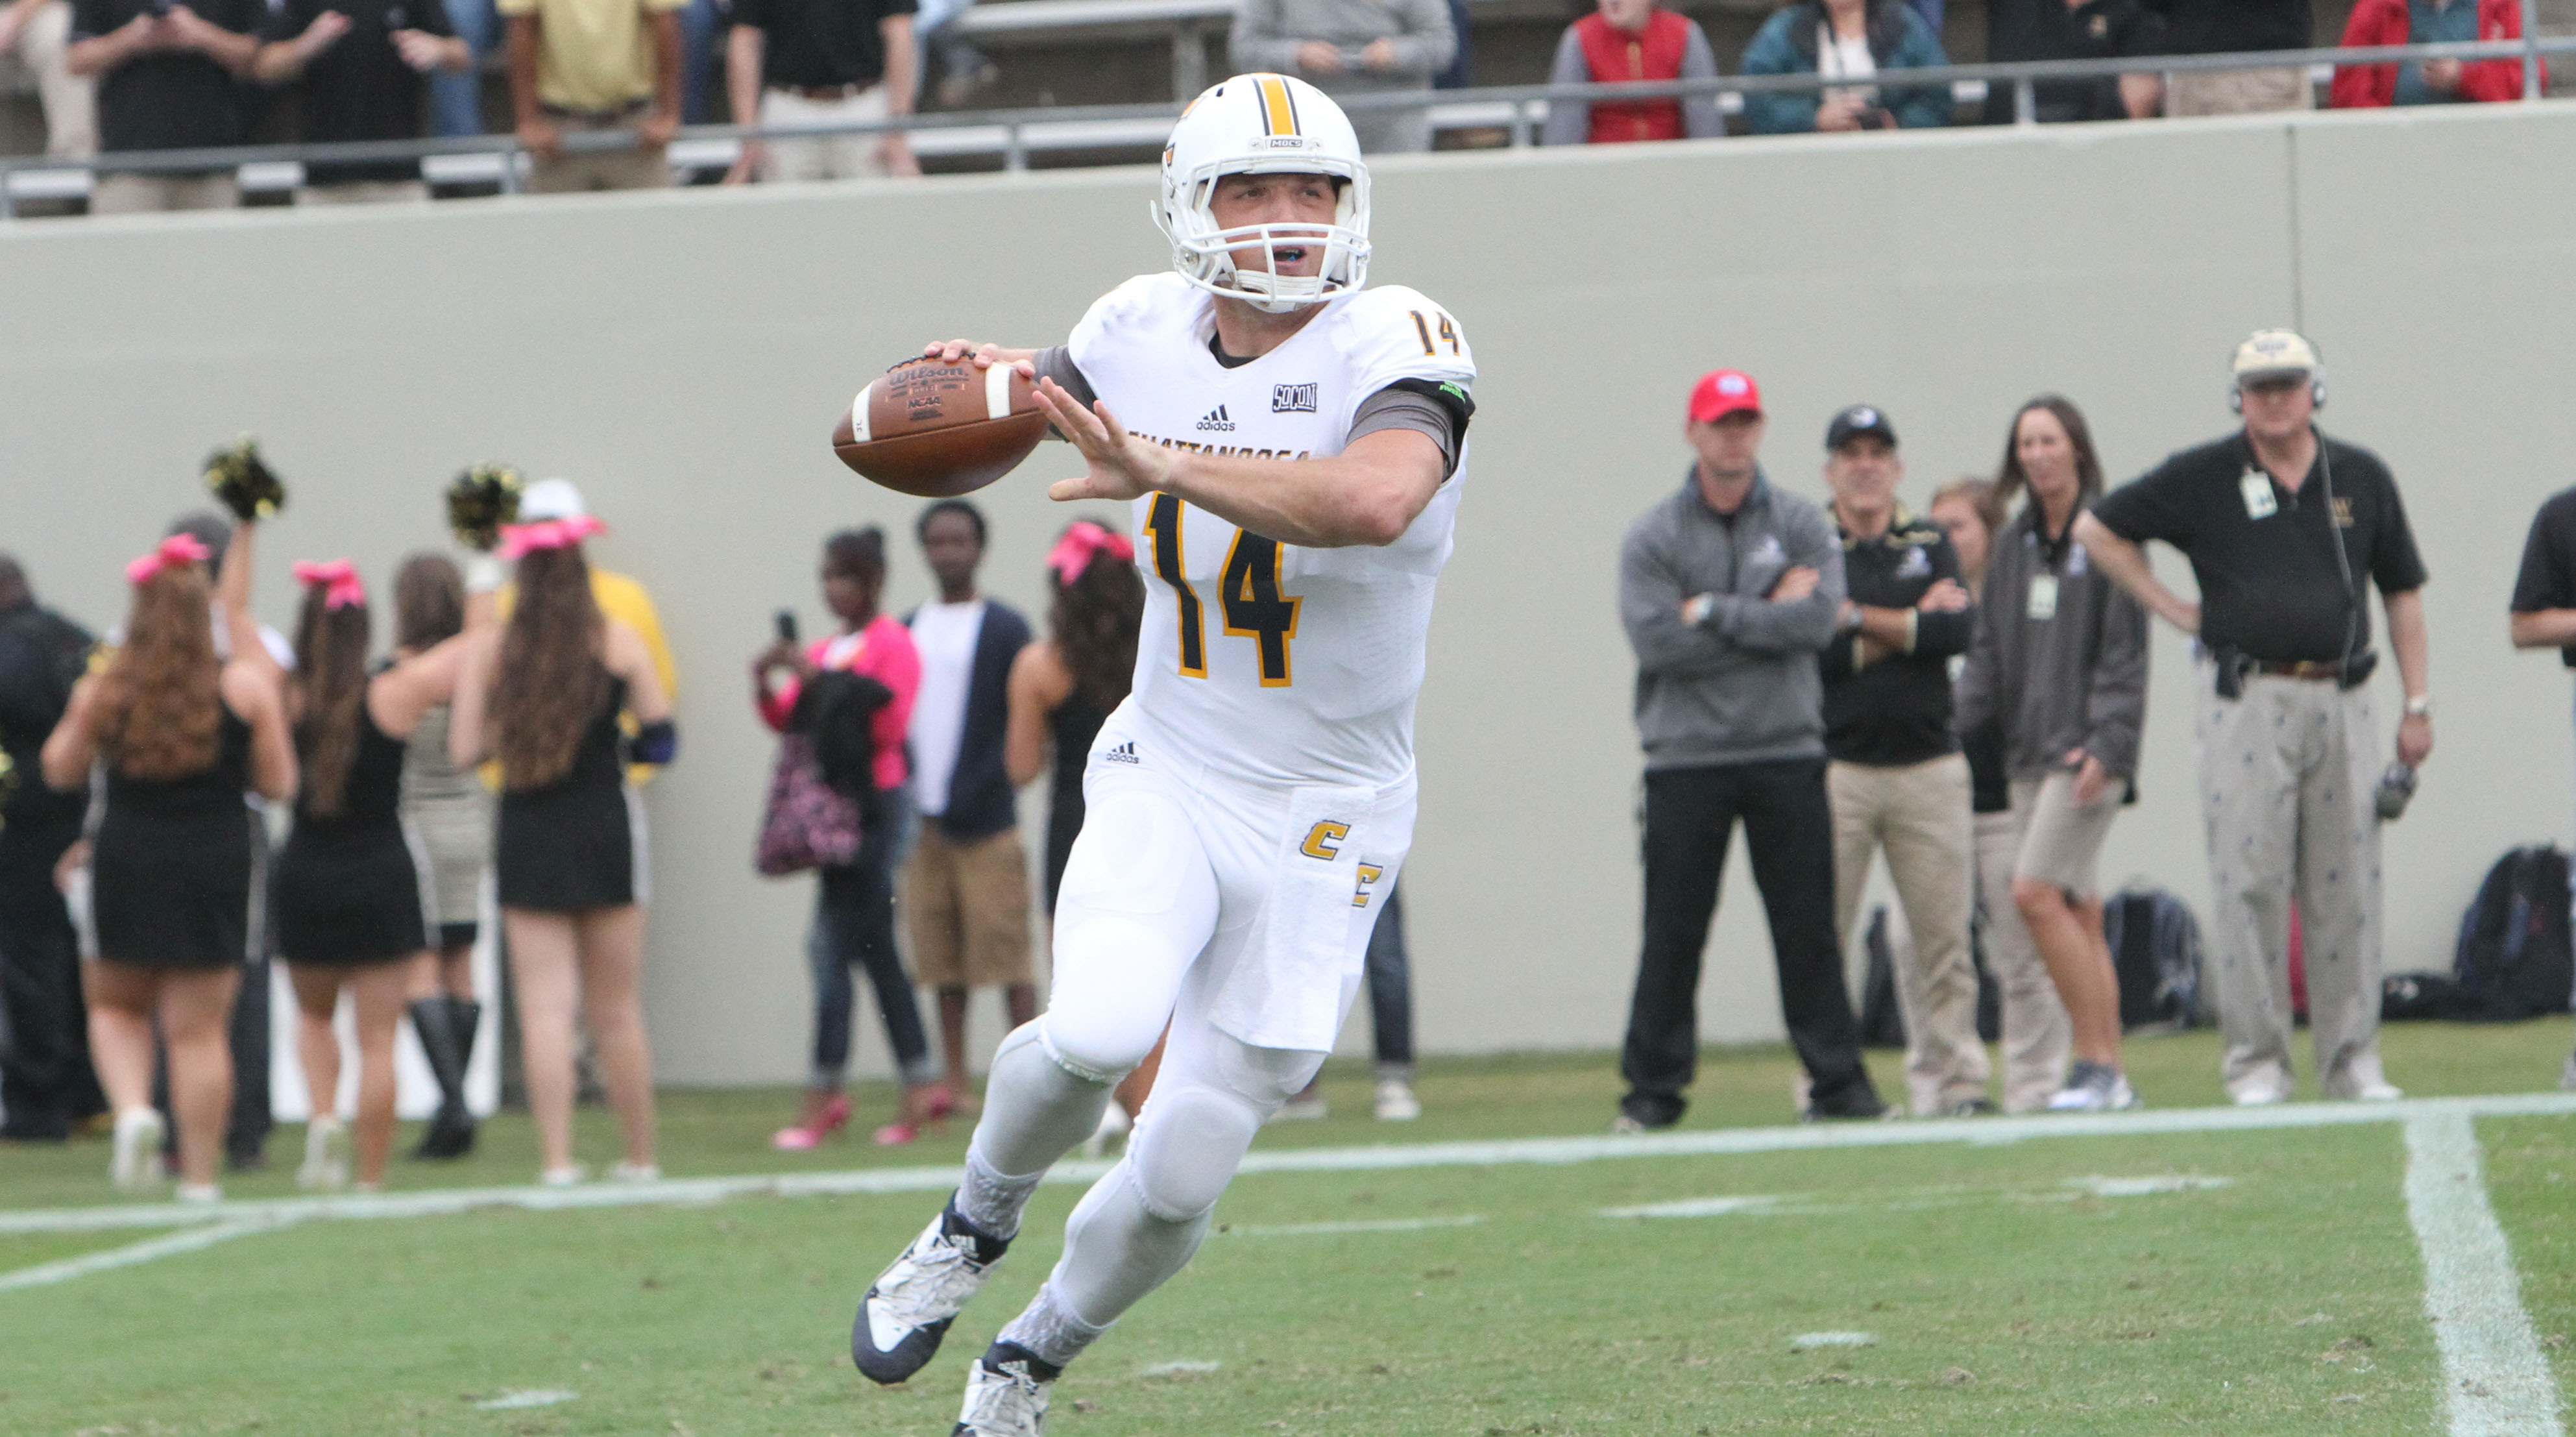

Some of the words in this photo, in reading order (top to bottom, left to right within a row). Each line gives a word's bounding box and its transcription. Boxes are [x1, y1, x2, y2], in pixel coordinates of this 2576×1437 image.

[1271, 139, 1302, 148] MOCS
[1408, 310, 1459, 356] 14
[908, 396, 943, 408] NCAA
[1273, 383, 1316, 410] SOCON
[1196, 419, 1235, 432] adidas
[1142, 489, 1304, 688] 14
[1106, 752, 1139, 764] adidas
[1300, 819, 1352, 861] C
